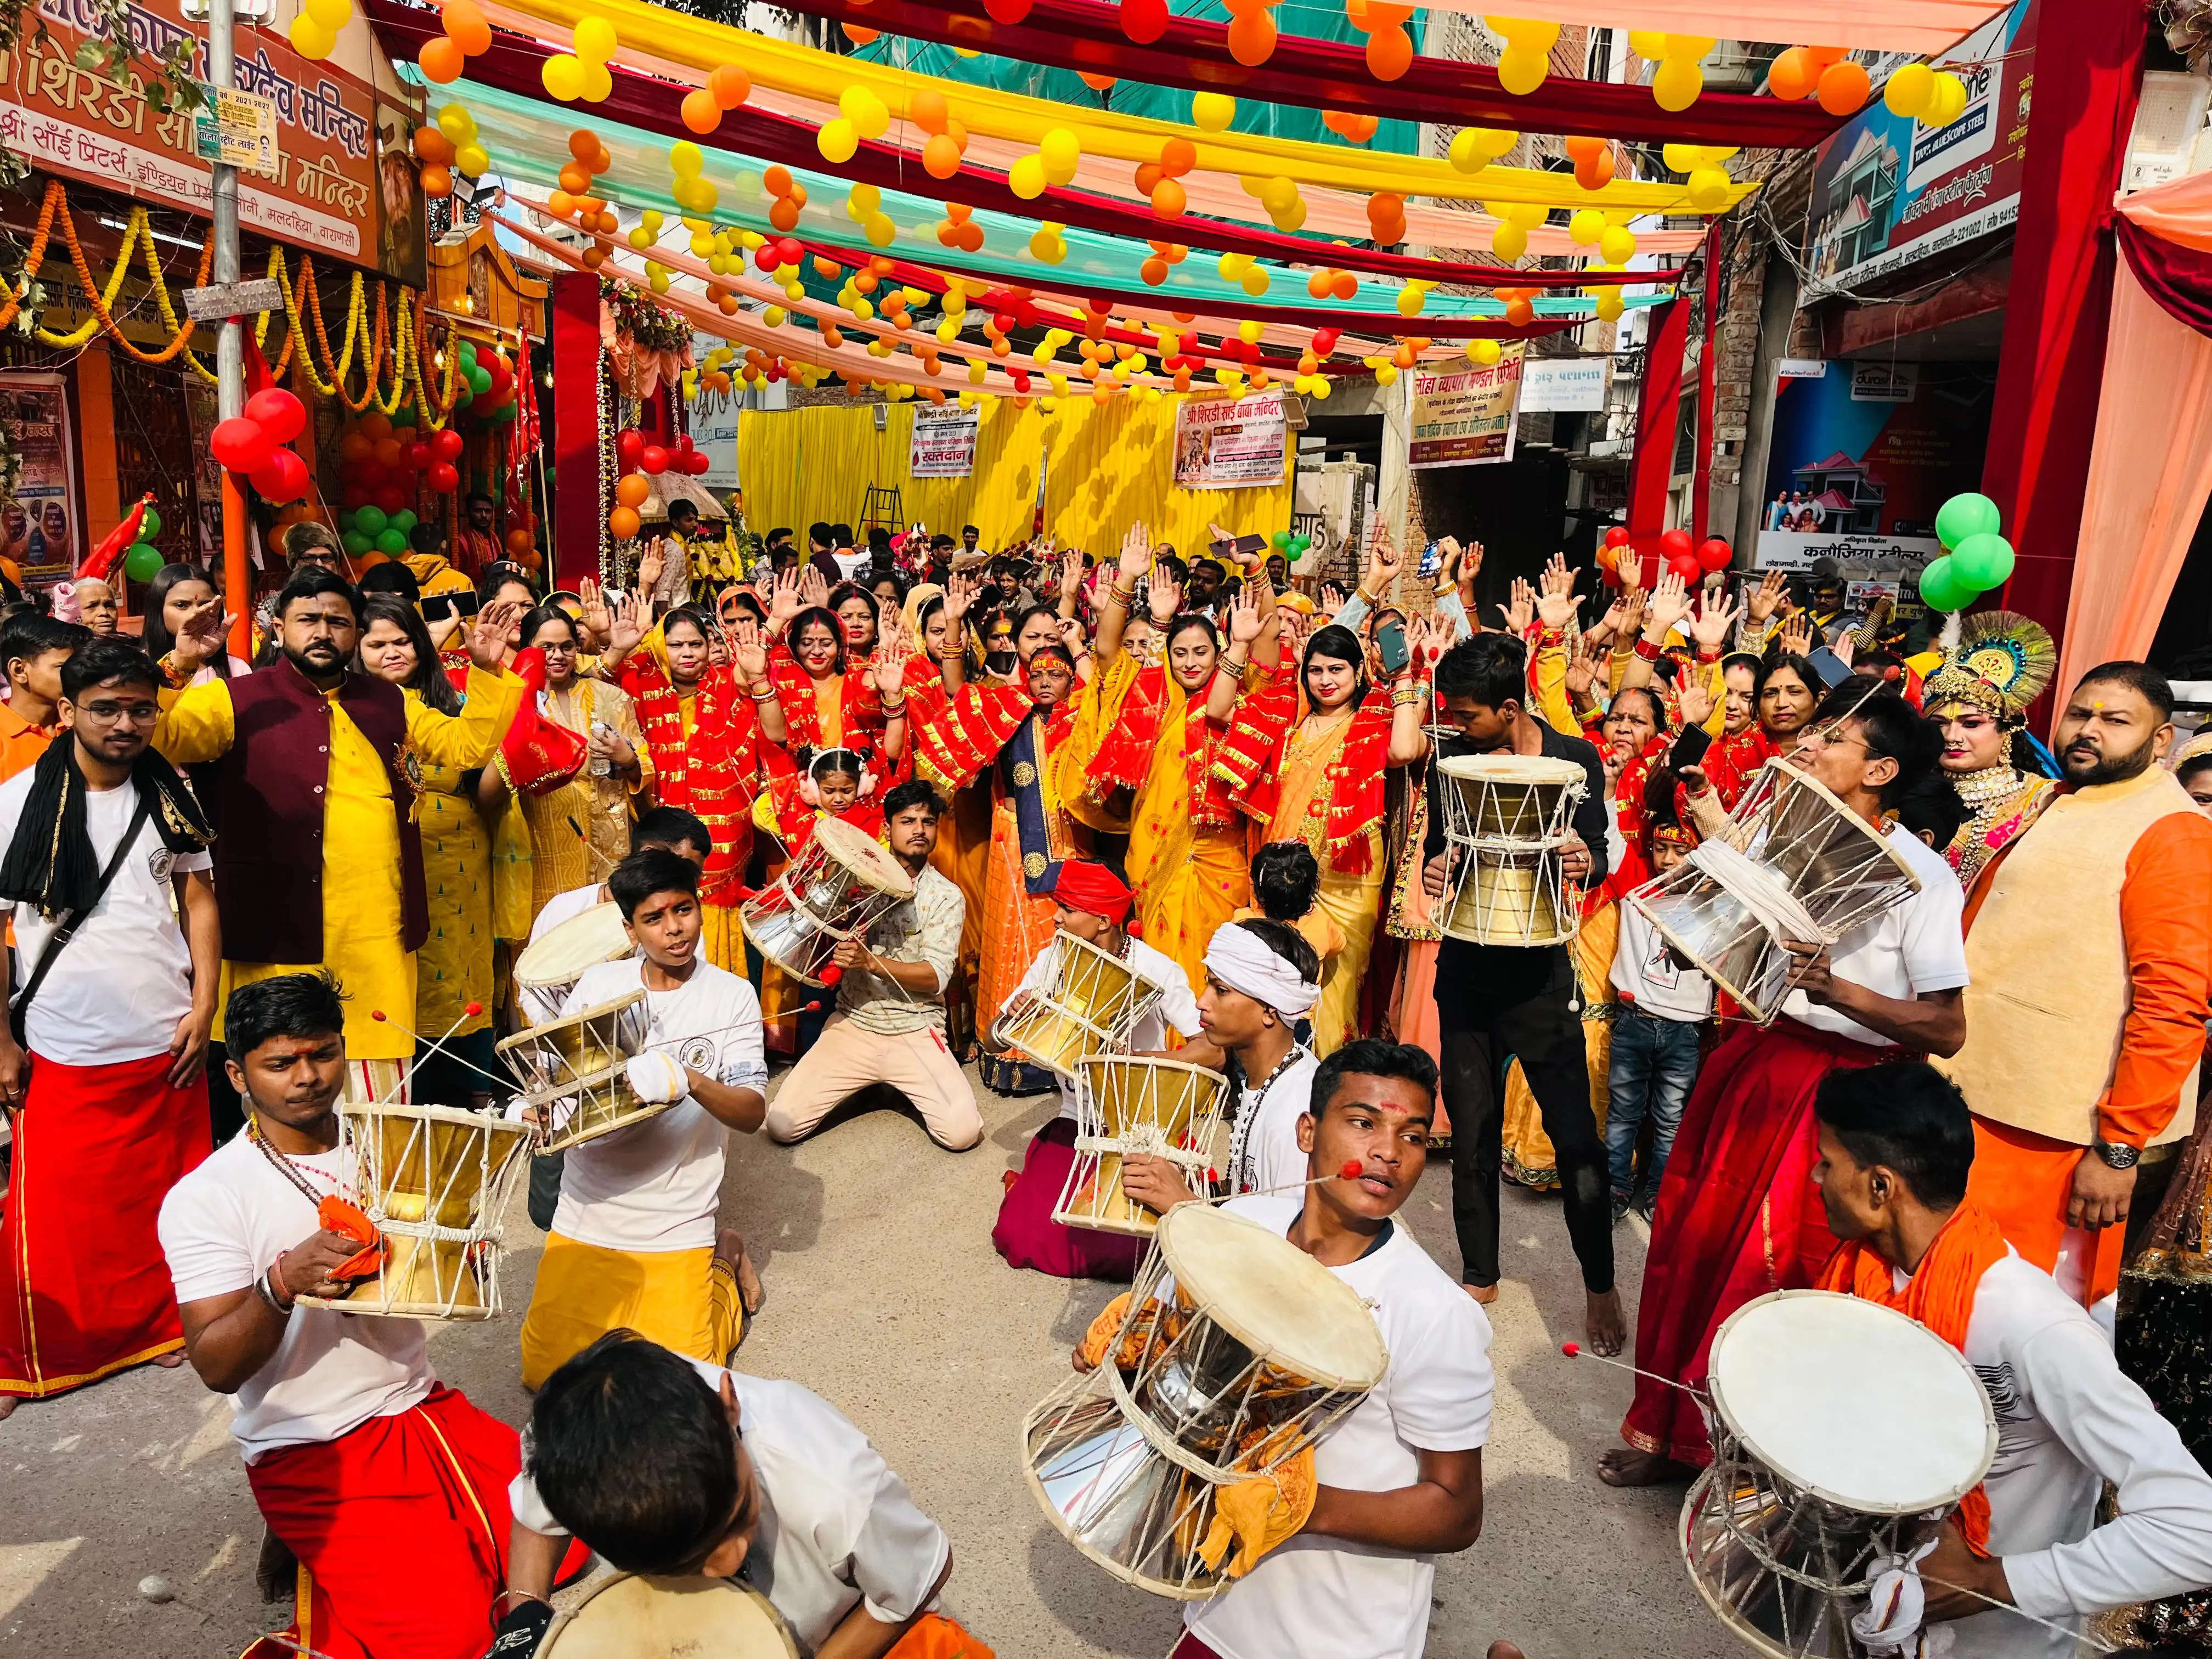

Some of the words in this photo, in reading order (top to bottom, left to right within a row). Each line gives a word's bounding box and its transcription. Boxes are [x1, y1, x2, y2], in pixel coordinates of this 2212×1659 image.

[198, 48, 296, 123] हादेव
[300, 79, 368, 160] मन्दिर
[26, 34, 148, 134] शिरडी
[296, 154, 369, 218] मन्दिर
[1967, 112, 1985, 133] STEEL
[0, 109, 27, 143] श्री
[138, 161, 187, 193] इण्डियन
[320, 225, 354, 249] वाराणसी
[1965, 169, 1975, 193] के
[1415, 373, 1437, 395] लोहा
[1438, 373, 1469, 393] व्यापार
[1469, 369, 1494, 389] मण्डल
[1187, 407, 1196, 425] श्री
[1198, 403, 1220, 424] शिरडी
[1238, 403, 1253, 419] बाबा
[1255, 397, 1282, 416] मन्दिर
[922, 450, 967, 462] रक्तदान
[1804, 542, 1875, 560] कनौजिया
[1765, 560, 1800, 568] लोहामण्डी,
